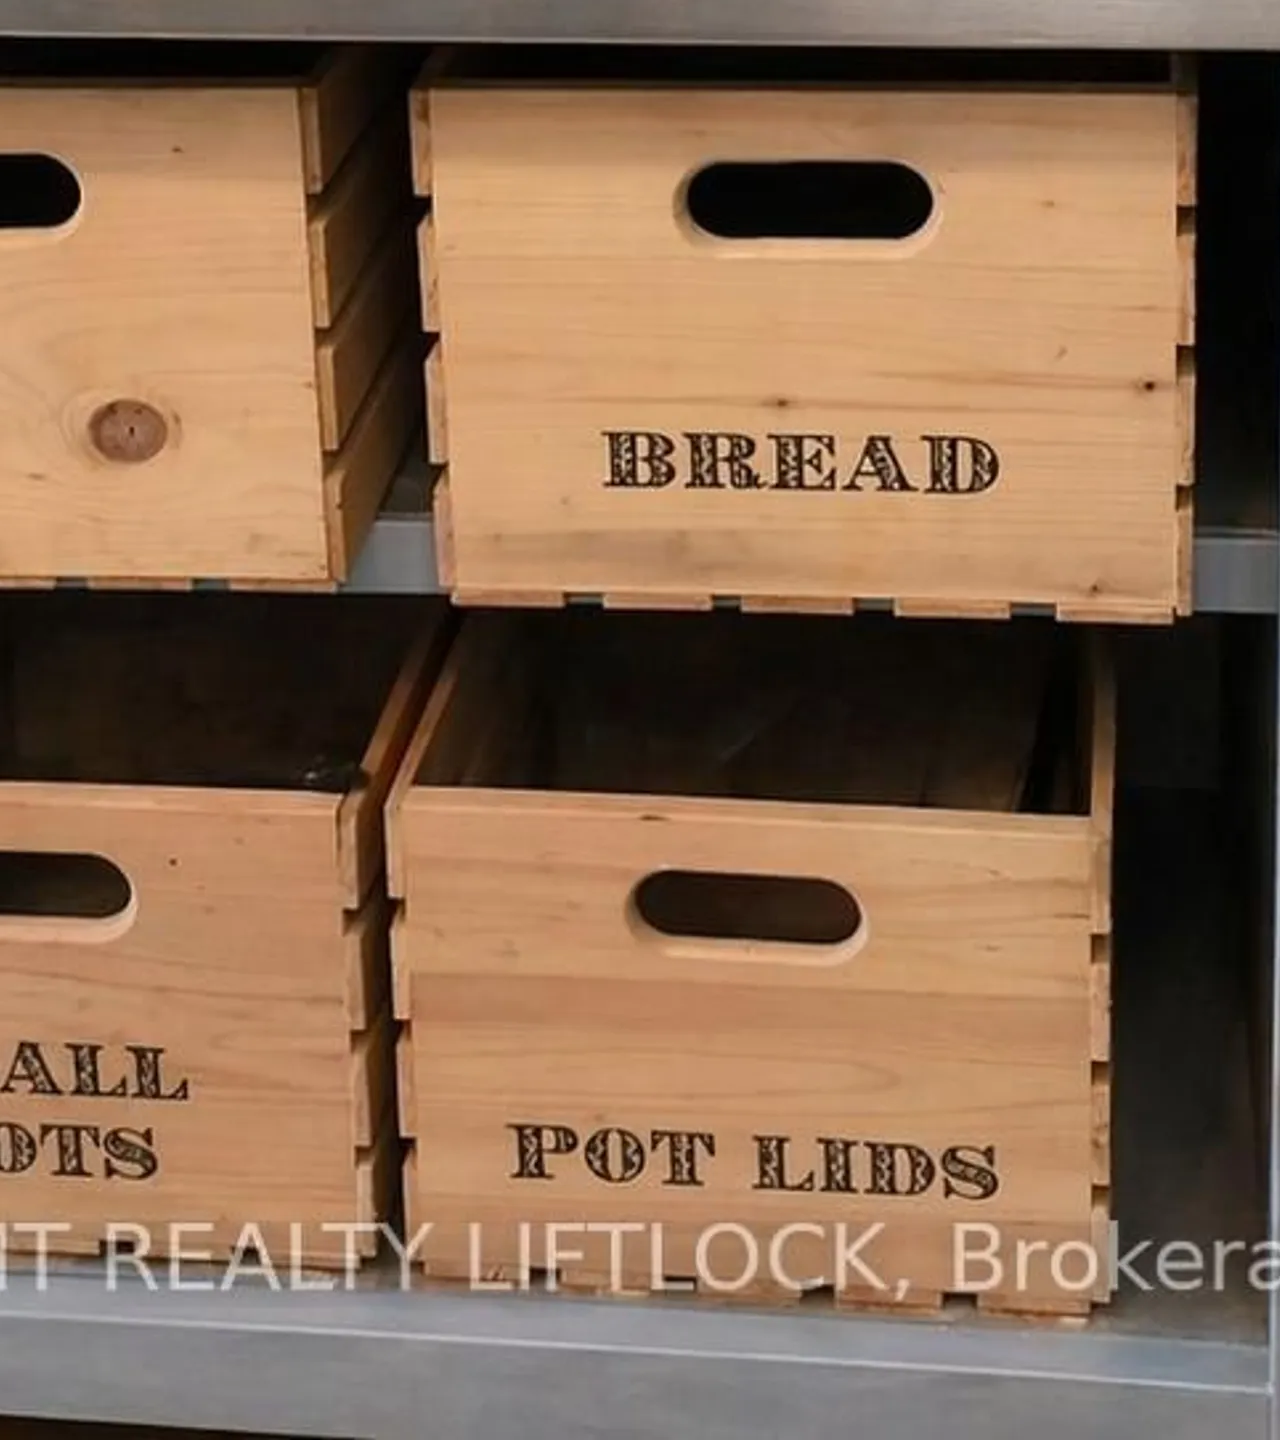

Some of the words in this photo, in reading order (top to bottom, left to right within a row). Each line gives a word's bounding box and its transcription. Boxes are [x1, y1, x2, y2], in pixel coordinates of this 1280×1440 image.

[601, 430, 1000, 496] BREAD
[505, 1122, 716, 1187] POT
[751, 1134, 1000, 1201] LIDS
